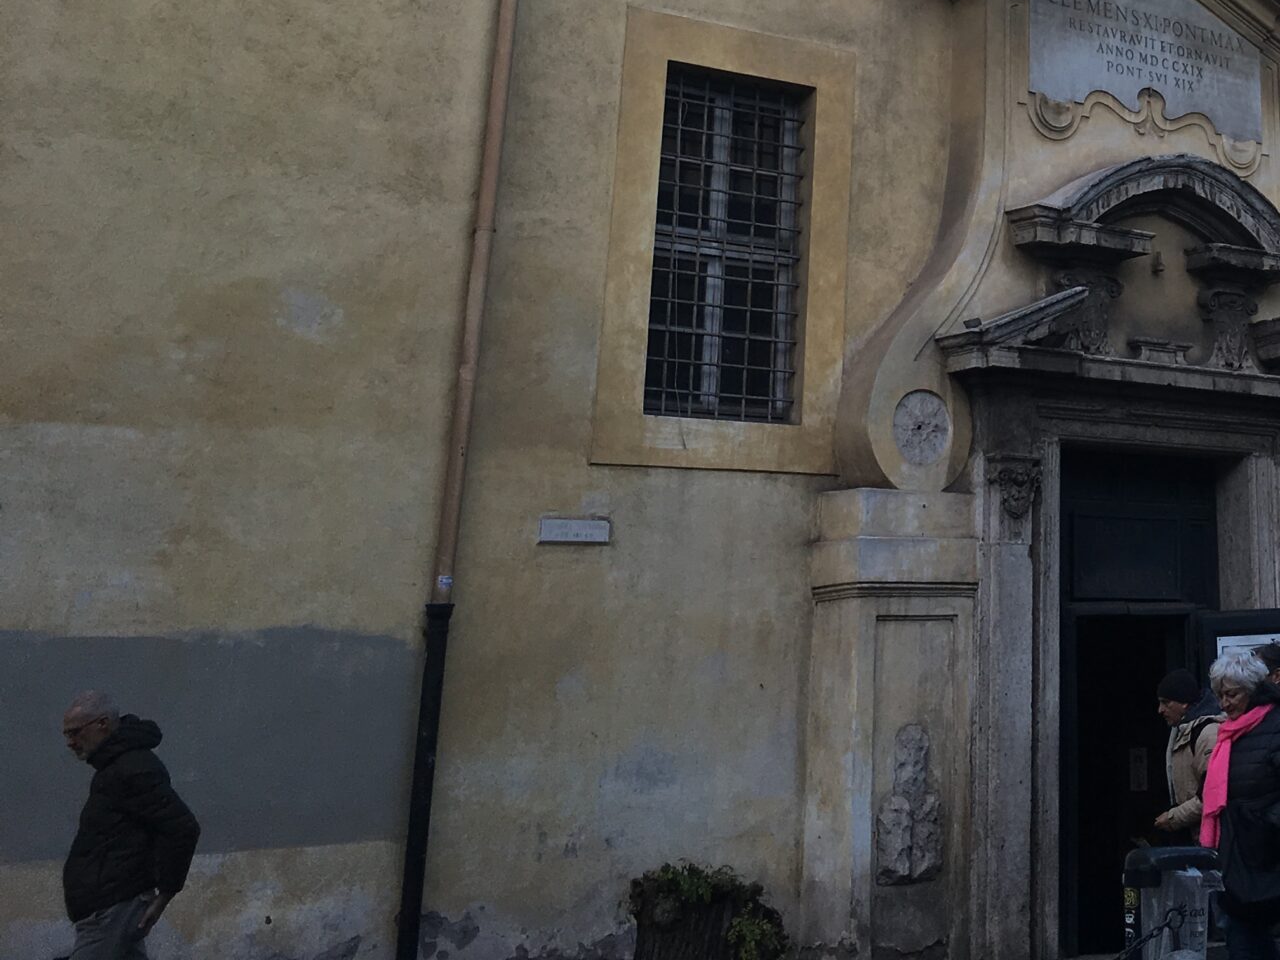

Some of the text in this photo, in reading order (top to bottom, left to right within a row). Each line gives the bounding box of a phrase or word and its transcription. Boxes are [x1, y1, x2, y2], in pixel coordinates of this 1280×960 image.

[1069, 17, 1231, 69] RESTAVRAVIT ET ORNAVIT
[1096, 42, 1203, 79] ANNO MDCCXIX
[1149, 71, 1167, 85] SVI
[1174, 77, 1194, 93] XIX
